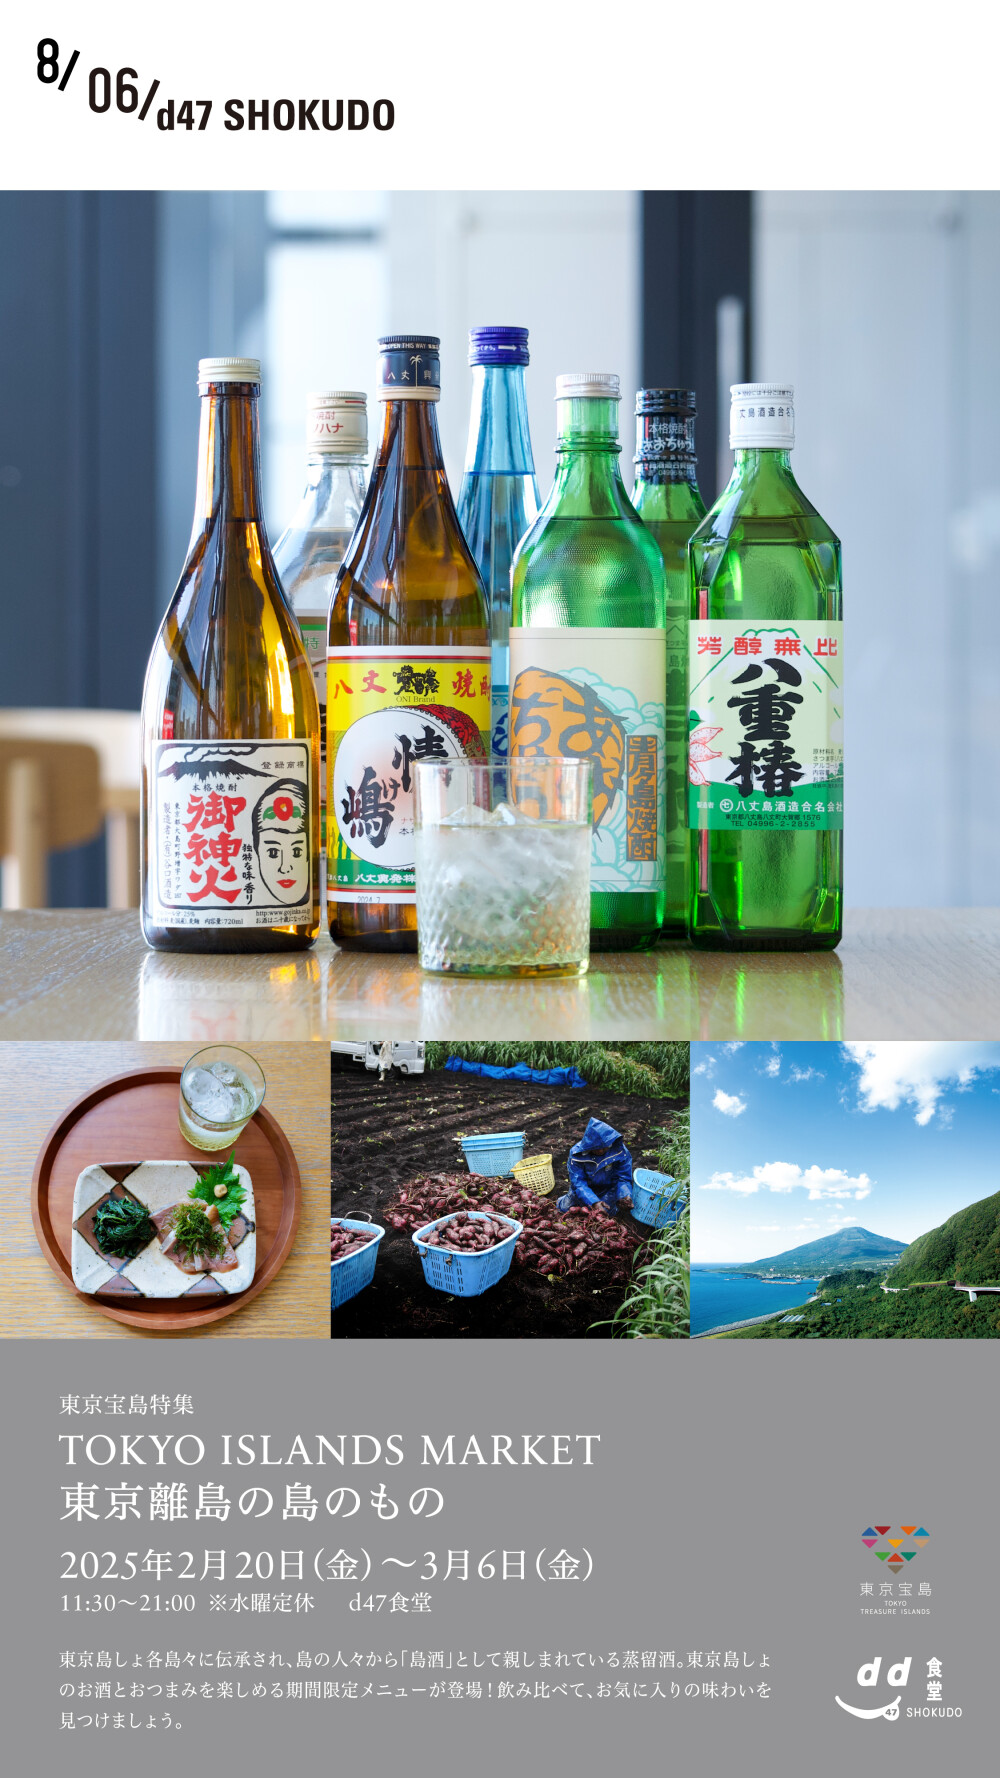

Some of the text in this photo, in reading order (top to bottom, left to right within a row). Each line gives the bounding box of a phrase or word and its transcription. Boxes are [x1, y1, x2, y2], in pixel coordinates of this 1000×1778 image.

[697, 636, 838, 657] 芳醇無比
[396, 695, 436, 703] ONI Brand
[725, 657, 806, 798] 八重椿
[261, 760, 305, 770] 登録商標
[192, 782, 238, 793] 本格焼酎
[736, 800, 843, 813] 八丈島酒造合名会社
[181, 790, 247, 904] 御神火
